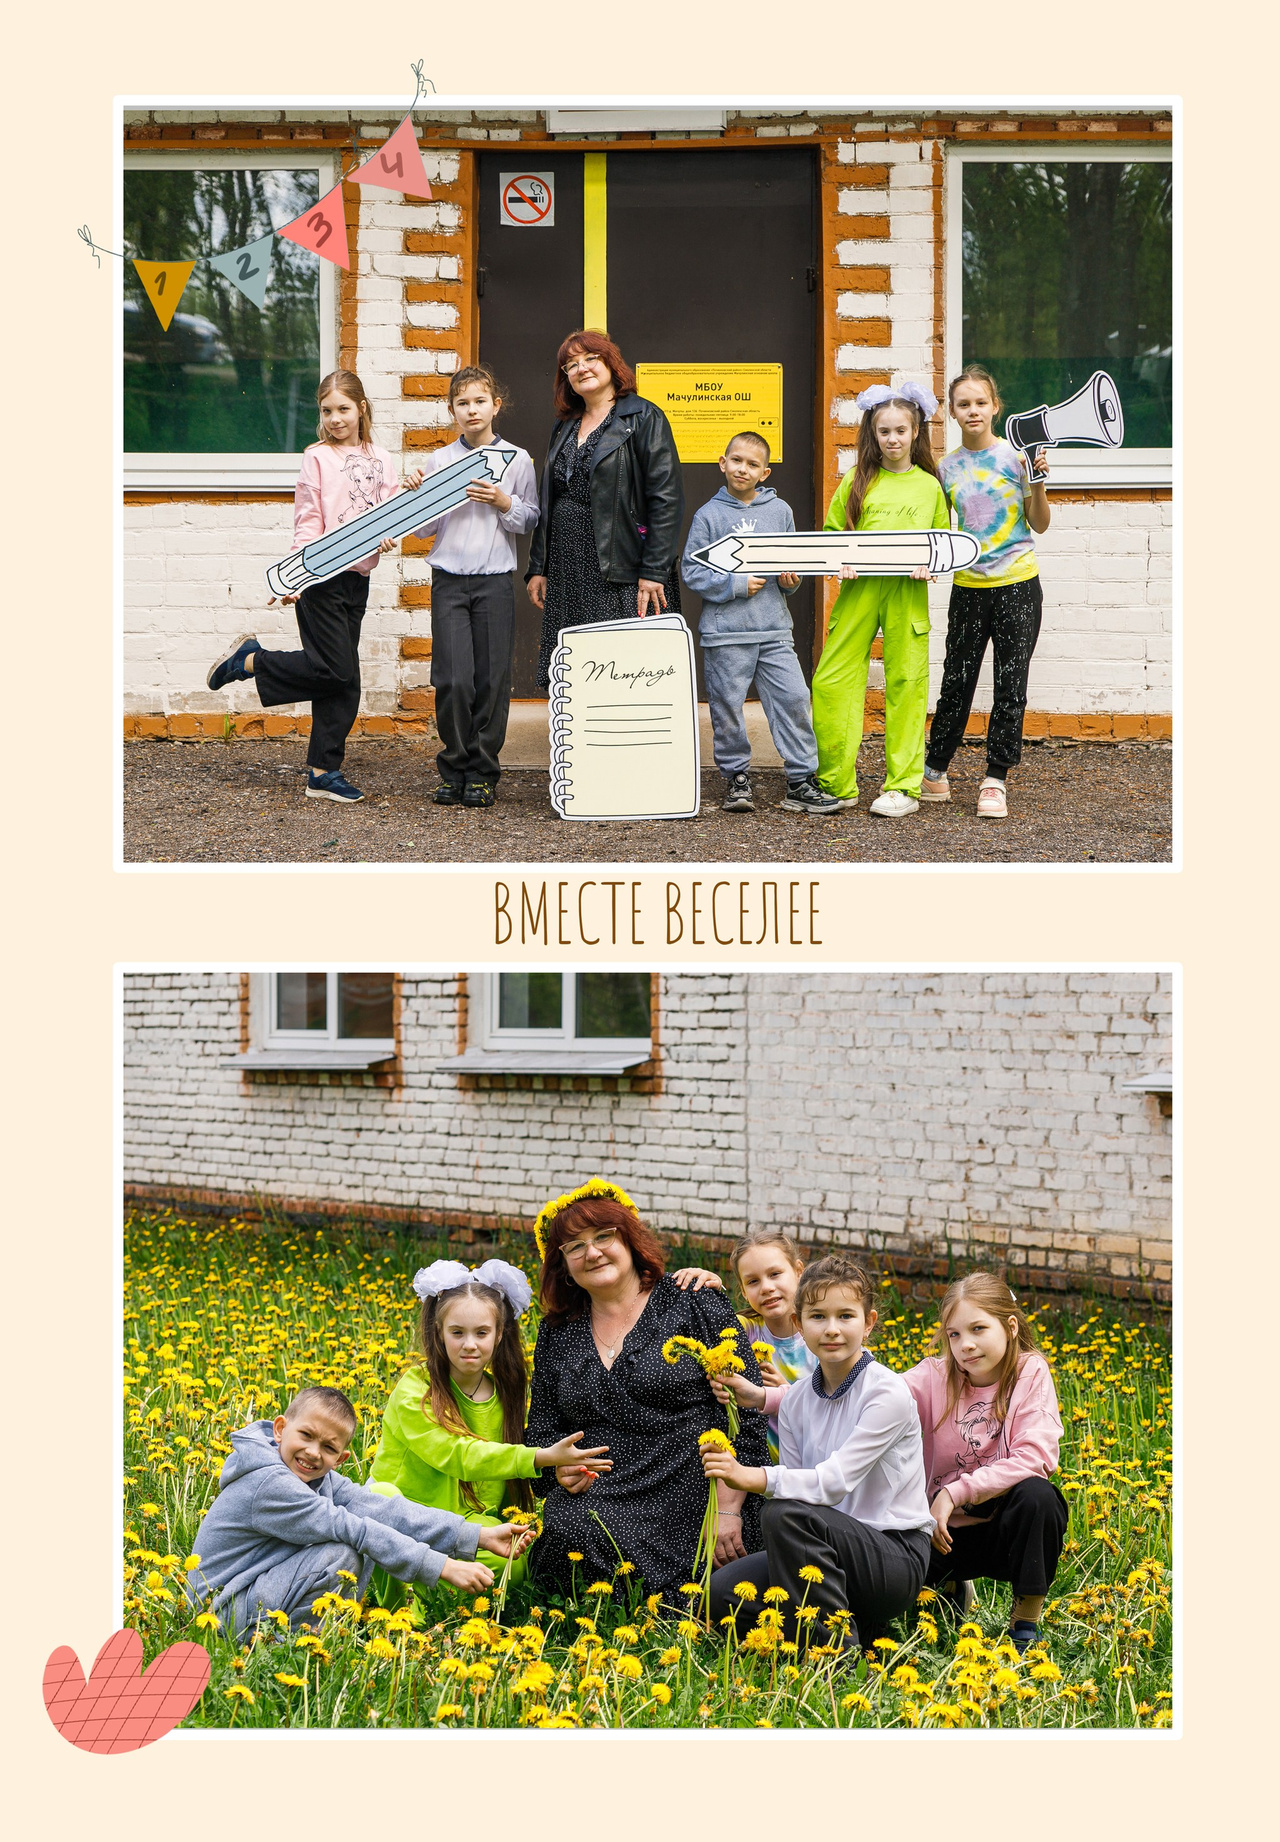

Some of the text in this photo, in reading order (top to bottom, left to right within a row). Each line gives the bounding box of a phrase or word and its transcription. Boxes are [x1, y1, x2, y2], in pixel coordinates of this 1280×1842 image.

[695, 382, 724, 392] МБОУ
[667, 392, 751, 403] Мачулинская ОШ
[581, 660, 676, 689] Тетрадь
